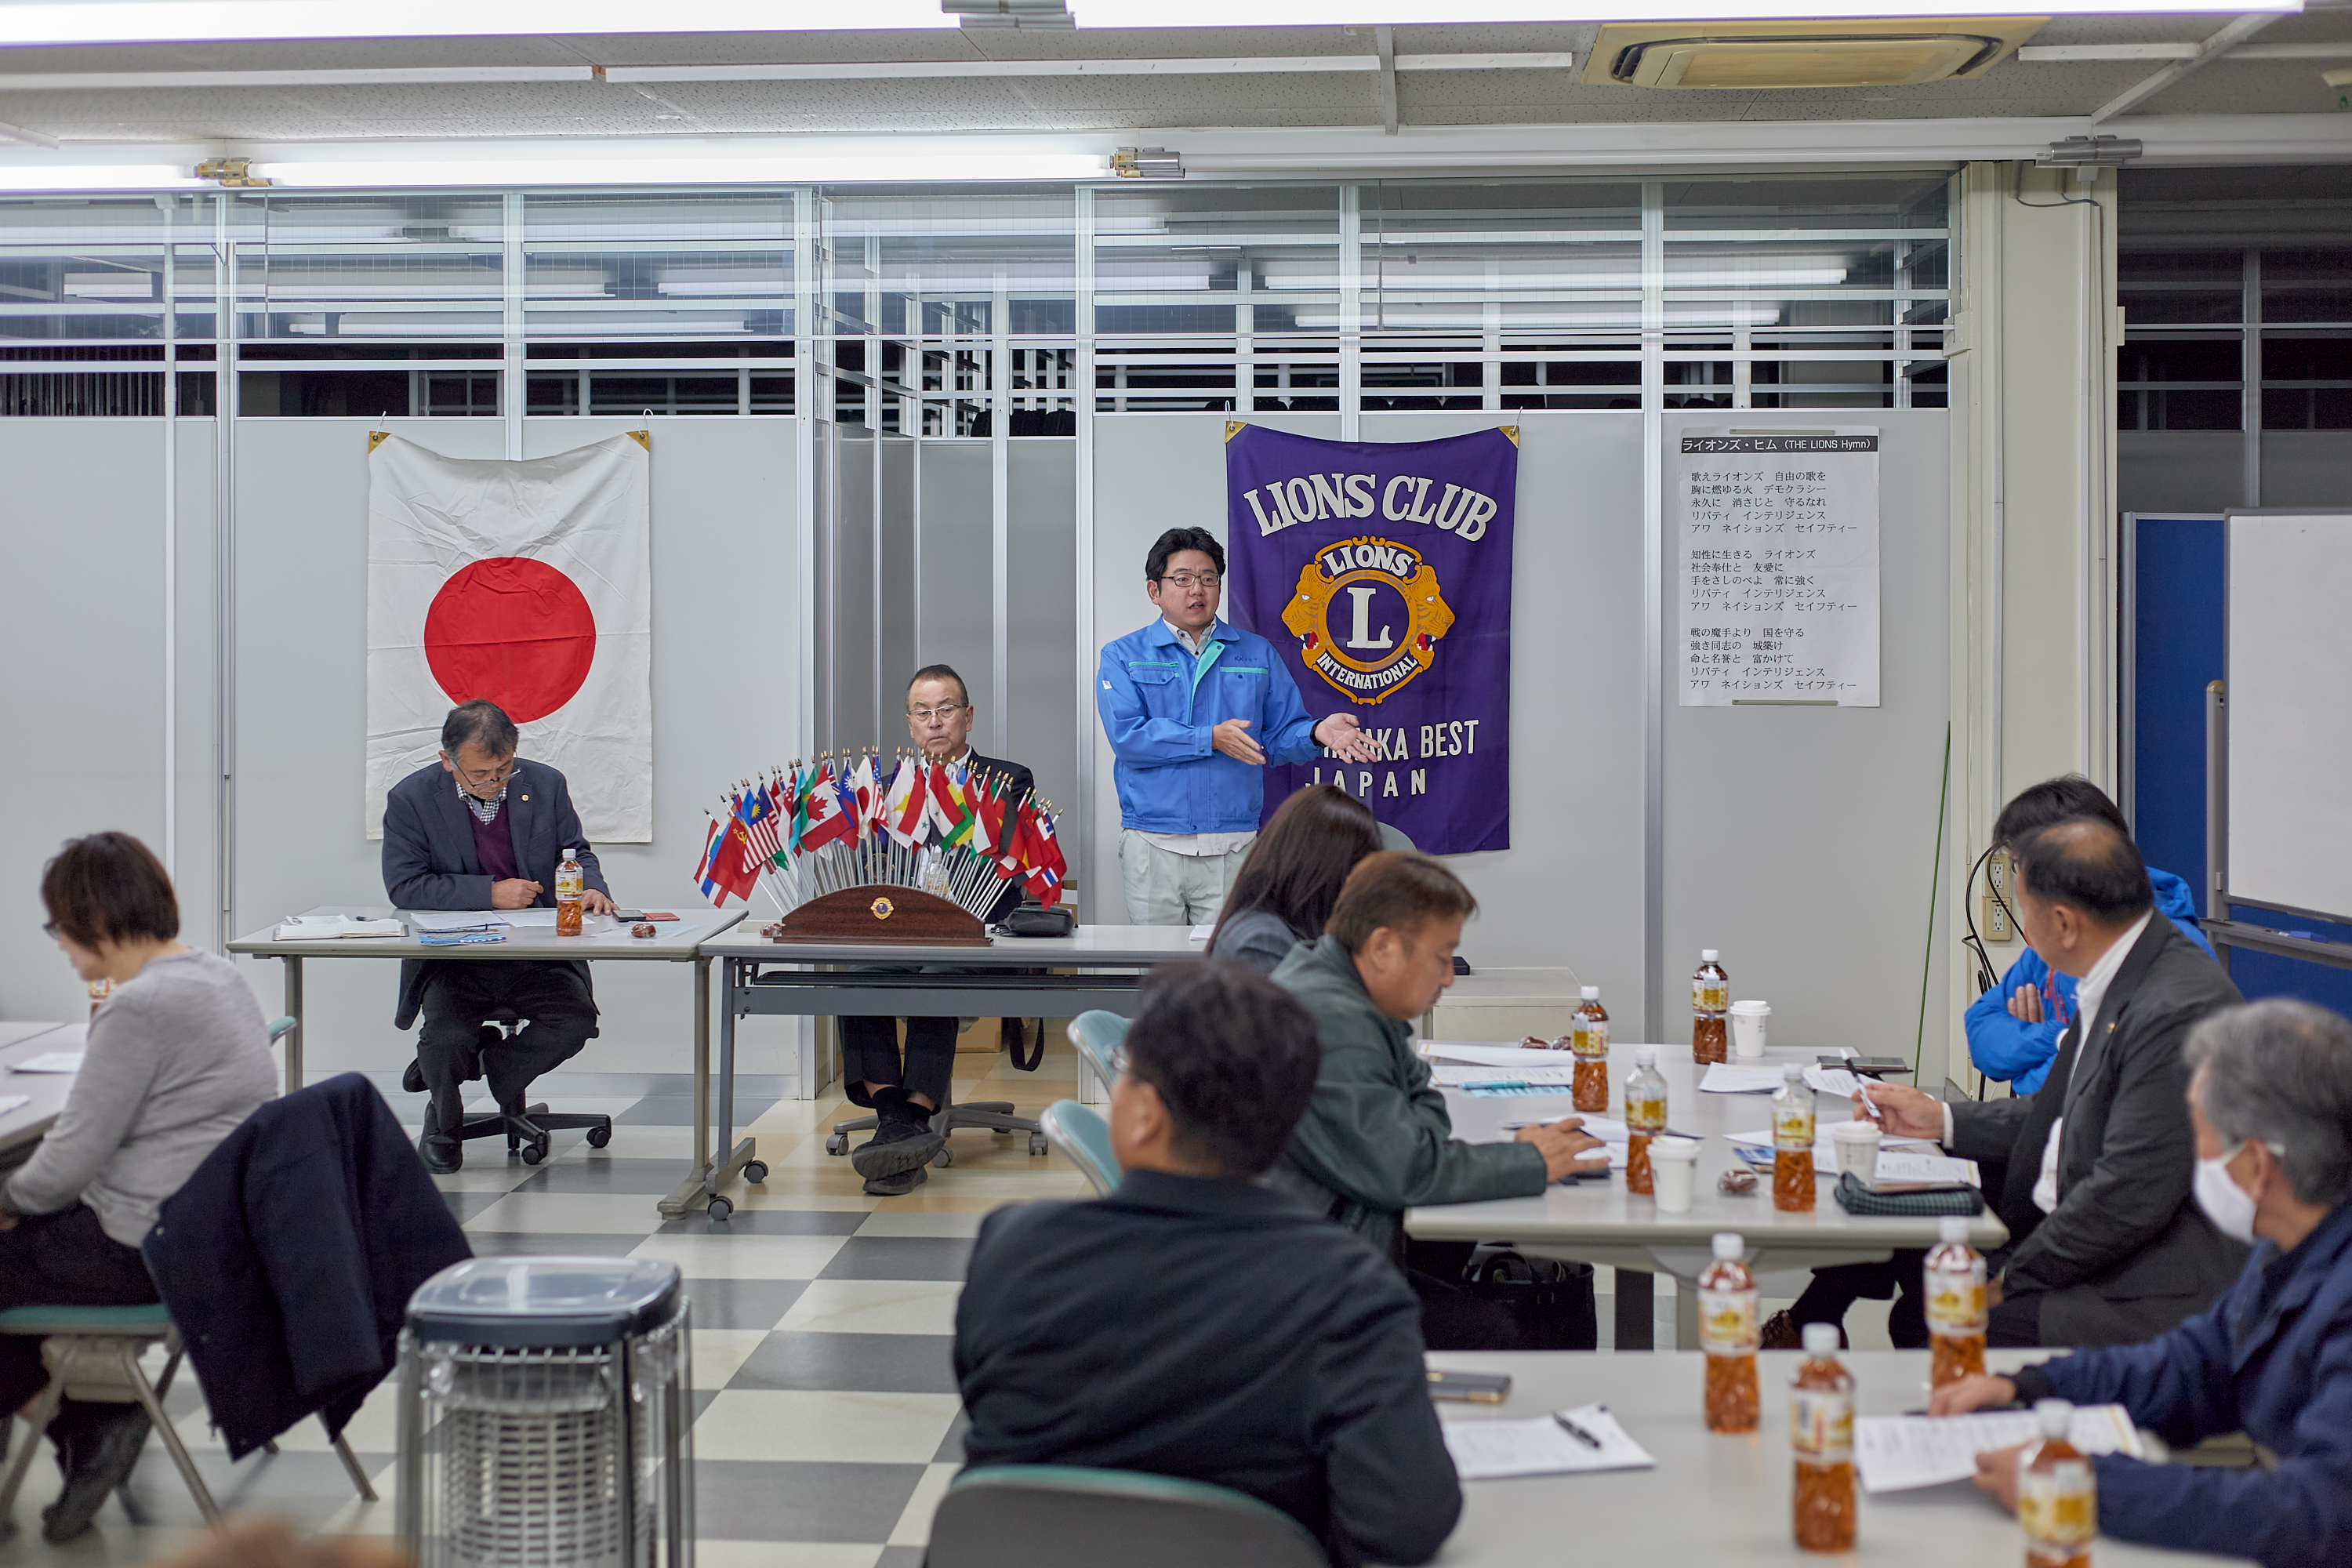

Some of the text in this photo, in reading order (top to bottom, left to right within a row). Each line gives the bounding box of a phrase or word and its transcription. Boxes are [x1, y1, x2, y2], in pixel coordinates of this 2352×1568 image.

[1682, 439, 1777, 451] ライオンズ・ヒム
[1810, 440, 1838, 449] LIONS
[1691, 472, 1826, 482] 歌えライオンズ 自由の歌を
[1691, 485, 1827, 495] 胸に燃ゆる火 デモクラシー
[1243, 473, 1498, 542] LIONS CLUB
[1691, 497, 1826, 508] 永久に 消さじと 守るなれ
[1692, 510, 1826, 521] リバティ インテリジェンス
[1691, 523, 1857, 534] アワ ネイションズ セイフティー
[1323, 545, 1415, 576] LIONS
[1691, 550, 1816, 560] 知性に生きる ライオンズ
[1691, 562, 1784, 572] 社会奉仕と 友愛に
[1691, 575, 1815, 586] 手をさしのべよ 常に強く
[1691, 588, 1826, 598] リバティ インテリジェンス
[1691, 601, 1857, 612] アワ ネイションズ セイフティー
[1346, 587, 1393, 649] L
[1690, 627, 1805, 637] 戦の魔手より 国を守る
[1690, 641, 1784, 651] 強き同志の 城築け
[1690, 654, 1794, 663] 命と名誉と 富かけて
[1316, 652, 1418, 690] INTERNATIONAL
[1691, 666, 1825, 677] リバティ インテリジェンス
[1690, 679, 1857, 690] アワ ネイションズ セイフティー
[1421, 720, 1480, 758] BEST
[1305, 766, 1427, 798] JAPAN
